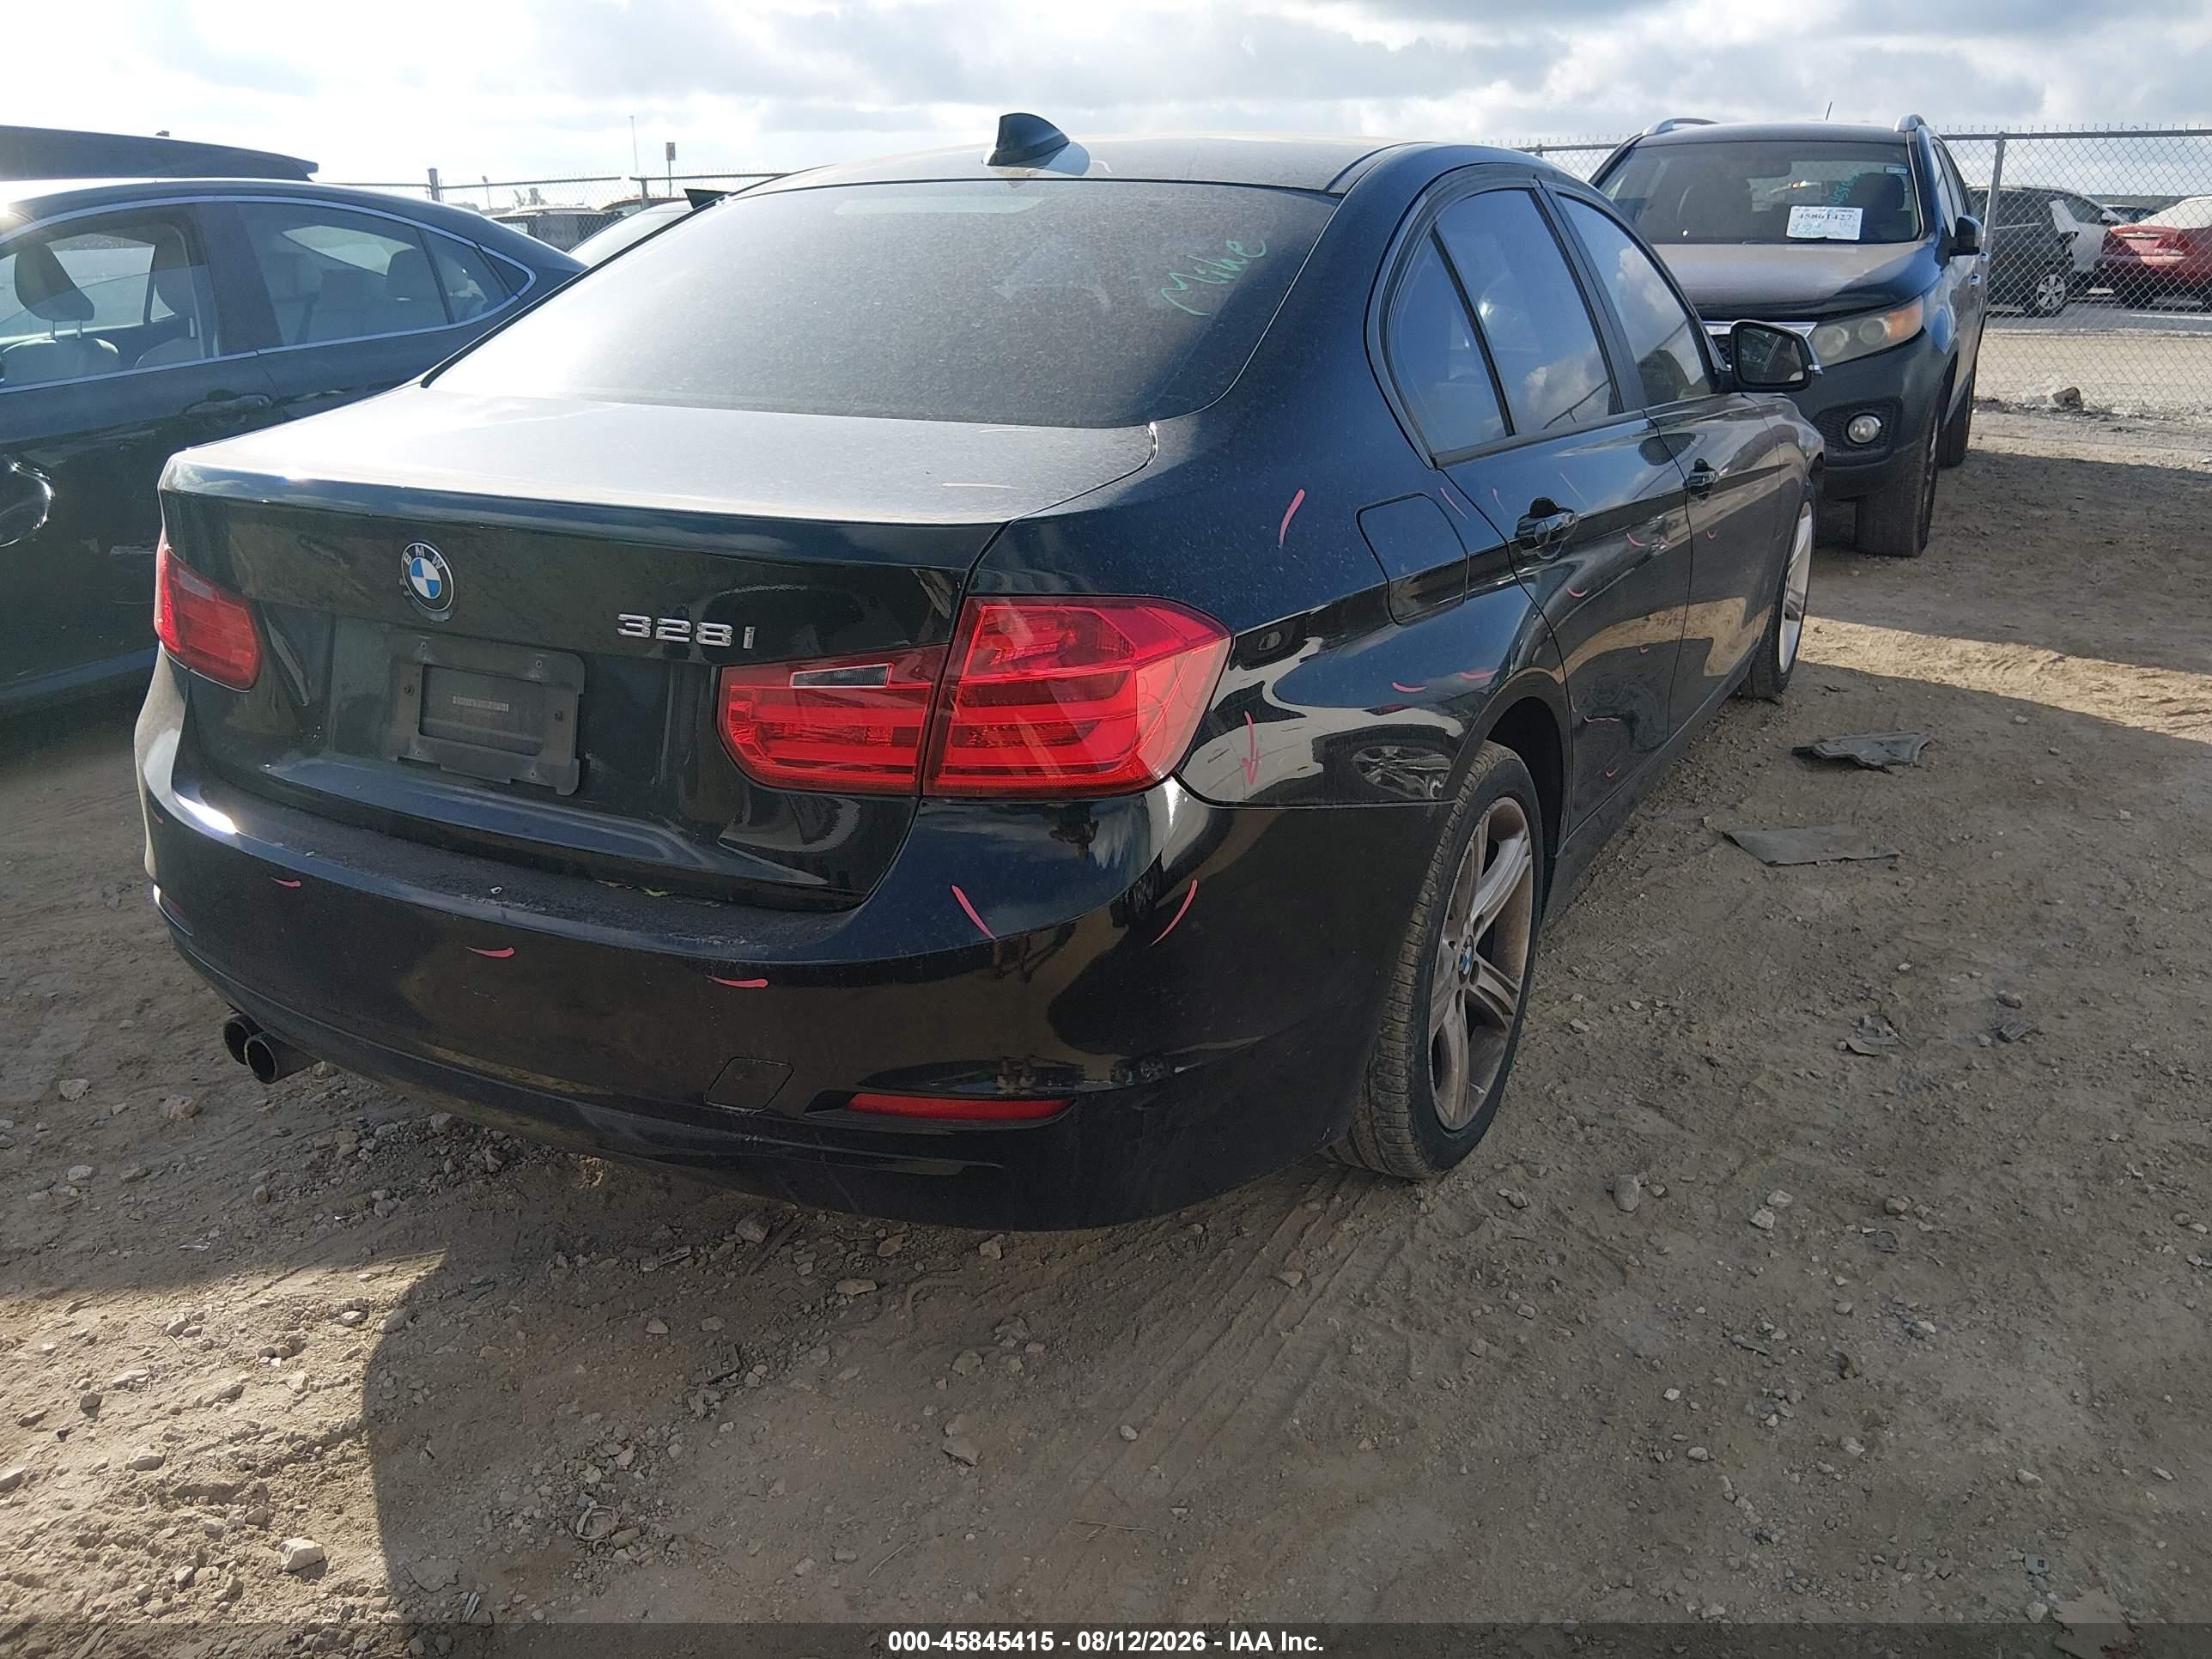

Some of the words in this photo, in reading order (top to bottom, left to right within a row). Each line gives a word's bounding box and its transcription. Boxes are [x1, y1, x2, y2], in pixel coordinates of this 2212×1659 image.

[1160, 239, 1267, 316] Mike
[403, 544, 445, 570] BMW
[617, 613, 756, 650] 328i
